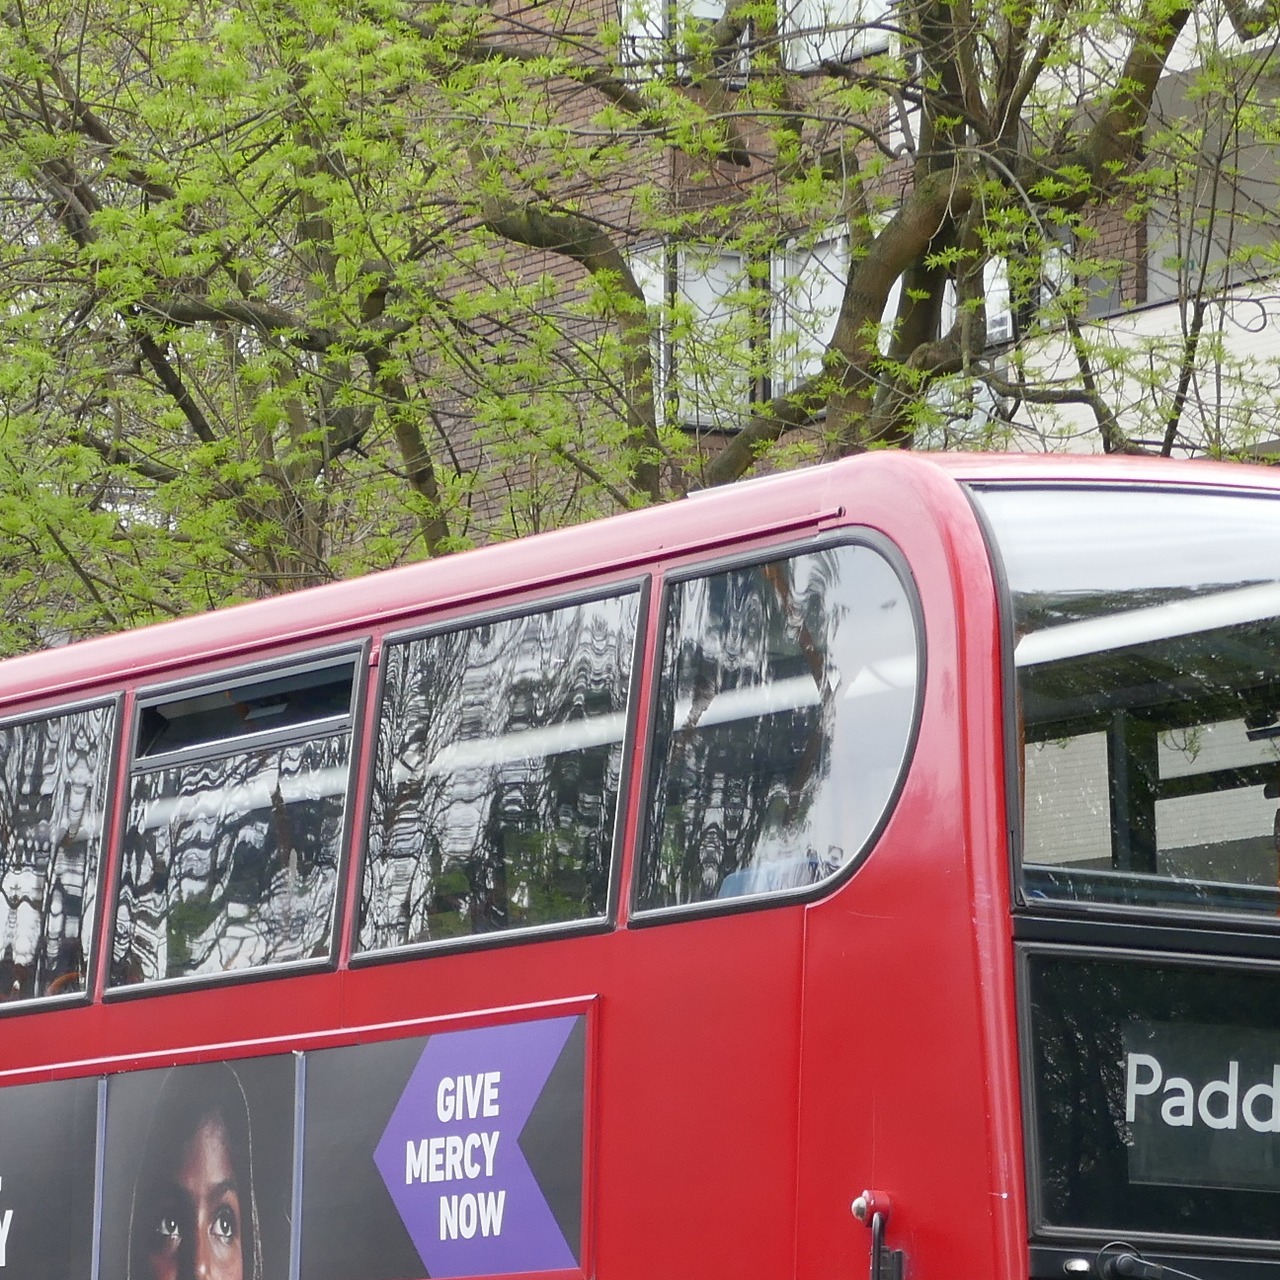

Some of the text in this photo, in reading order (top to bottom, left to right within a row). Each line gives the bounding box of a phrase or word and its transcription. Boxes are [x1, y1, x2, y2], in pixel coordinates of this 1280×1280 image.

[436, 1070, 502, 1123] GIVE
[405, 1130, 501, 1185] MERCY
[439, 1189, 507, 1241] NOW
